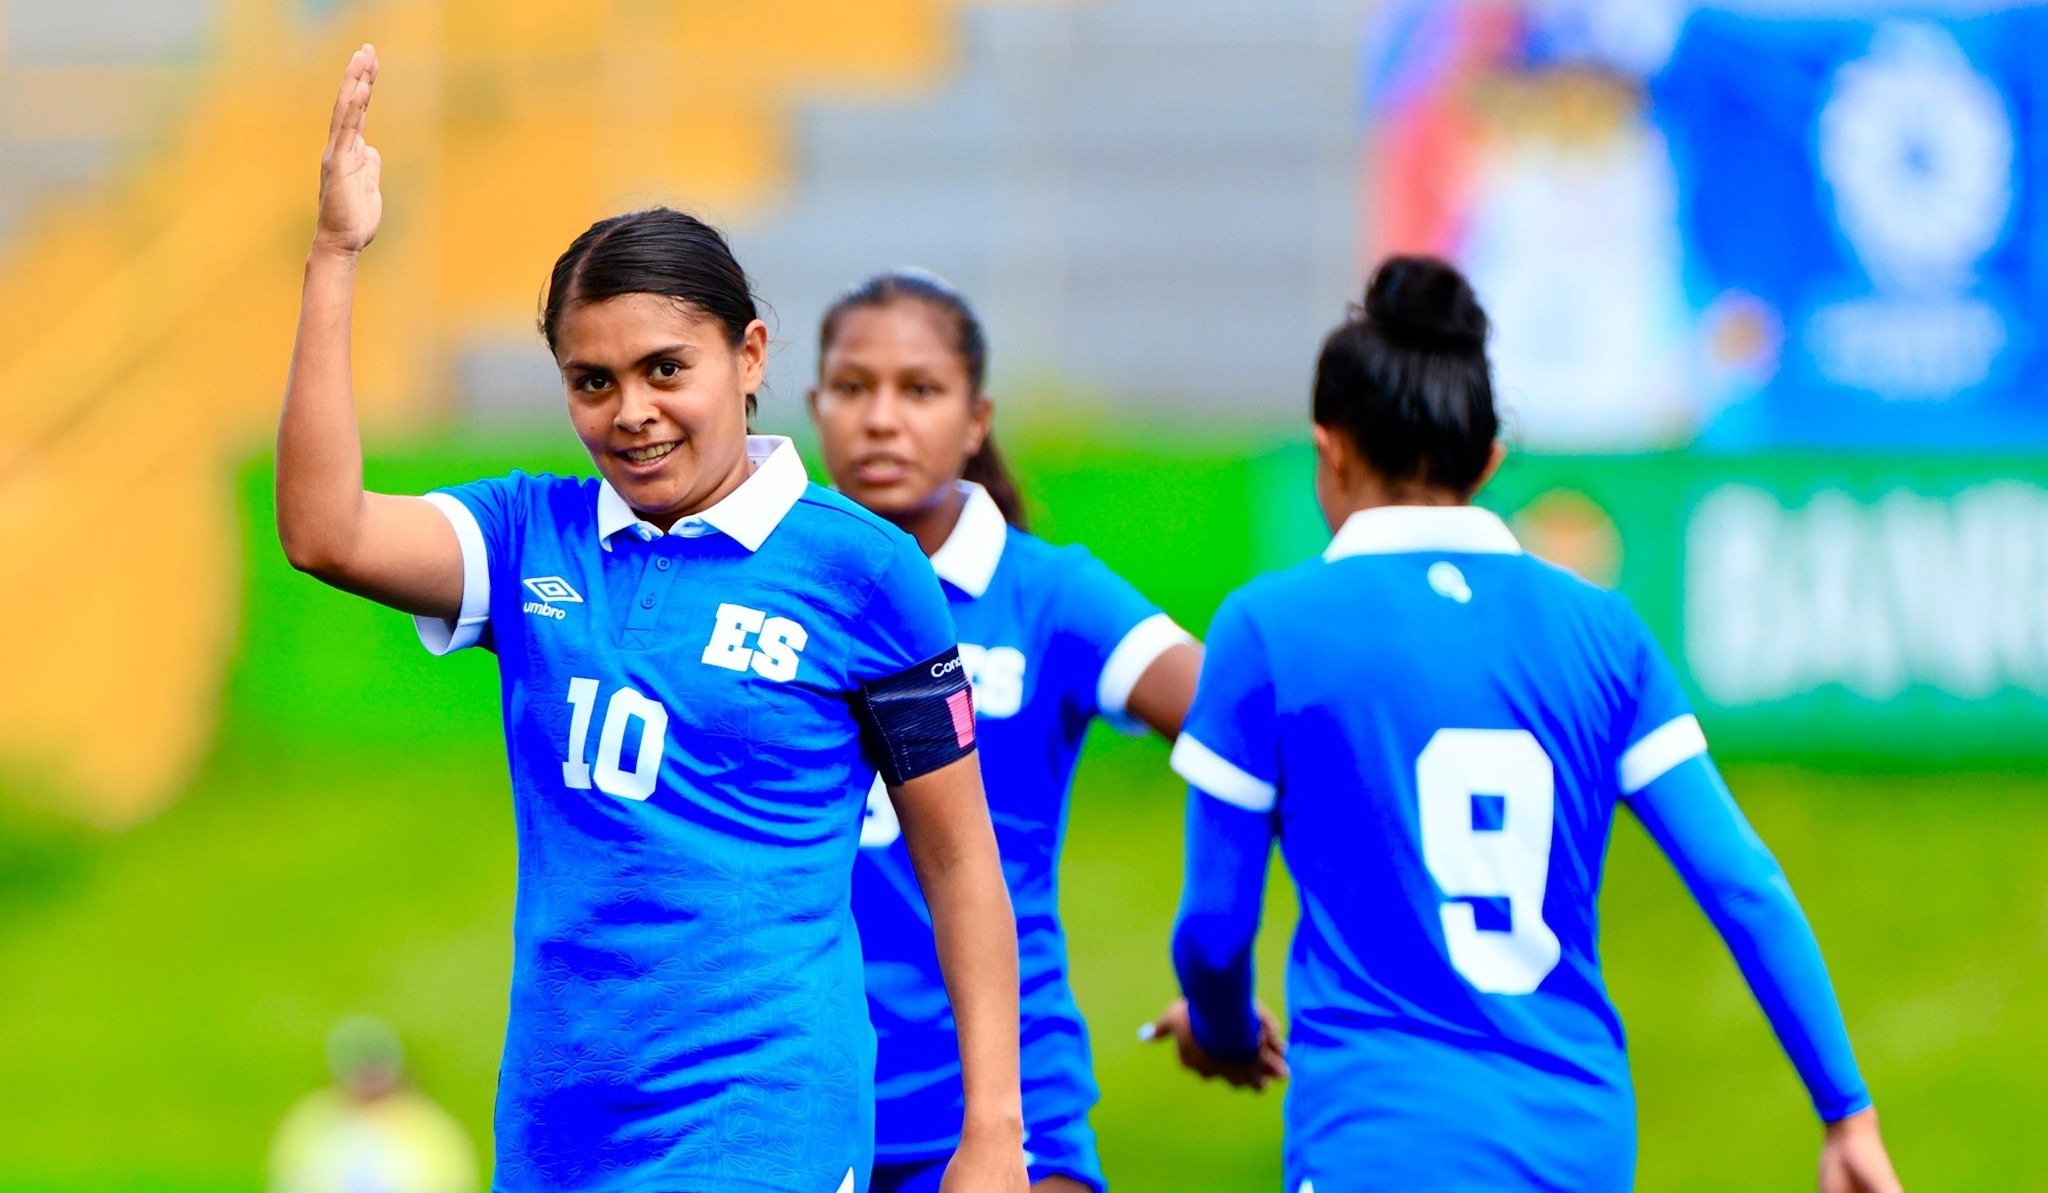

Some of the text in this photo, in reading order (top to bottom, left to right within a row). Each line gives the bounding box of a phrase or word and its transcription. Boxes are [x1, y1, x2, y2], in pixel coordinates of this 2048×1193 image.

[523, 602, 566, 620] umbro
[701, 602, 809, 683] ES
[562, 676, 669, 802] 10
[1416, 728, 1561, 996] 9
